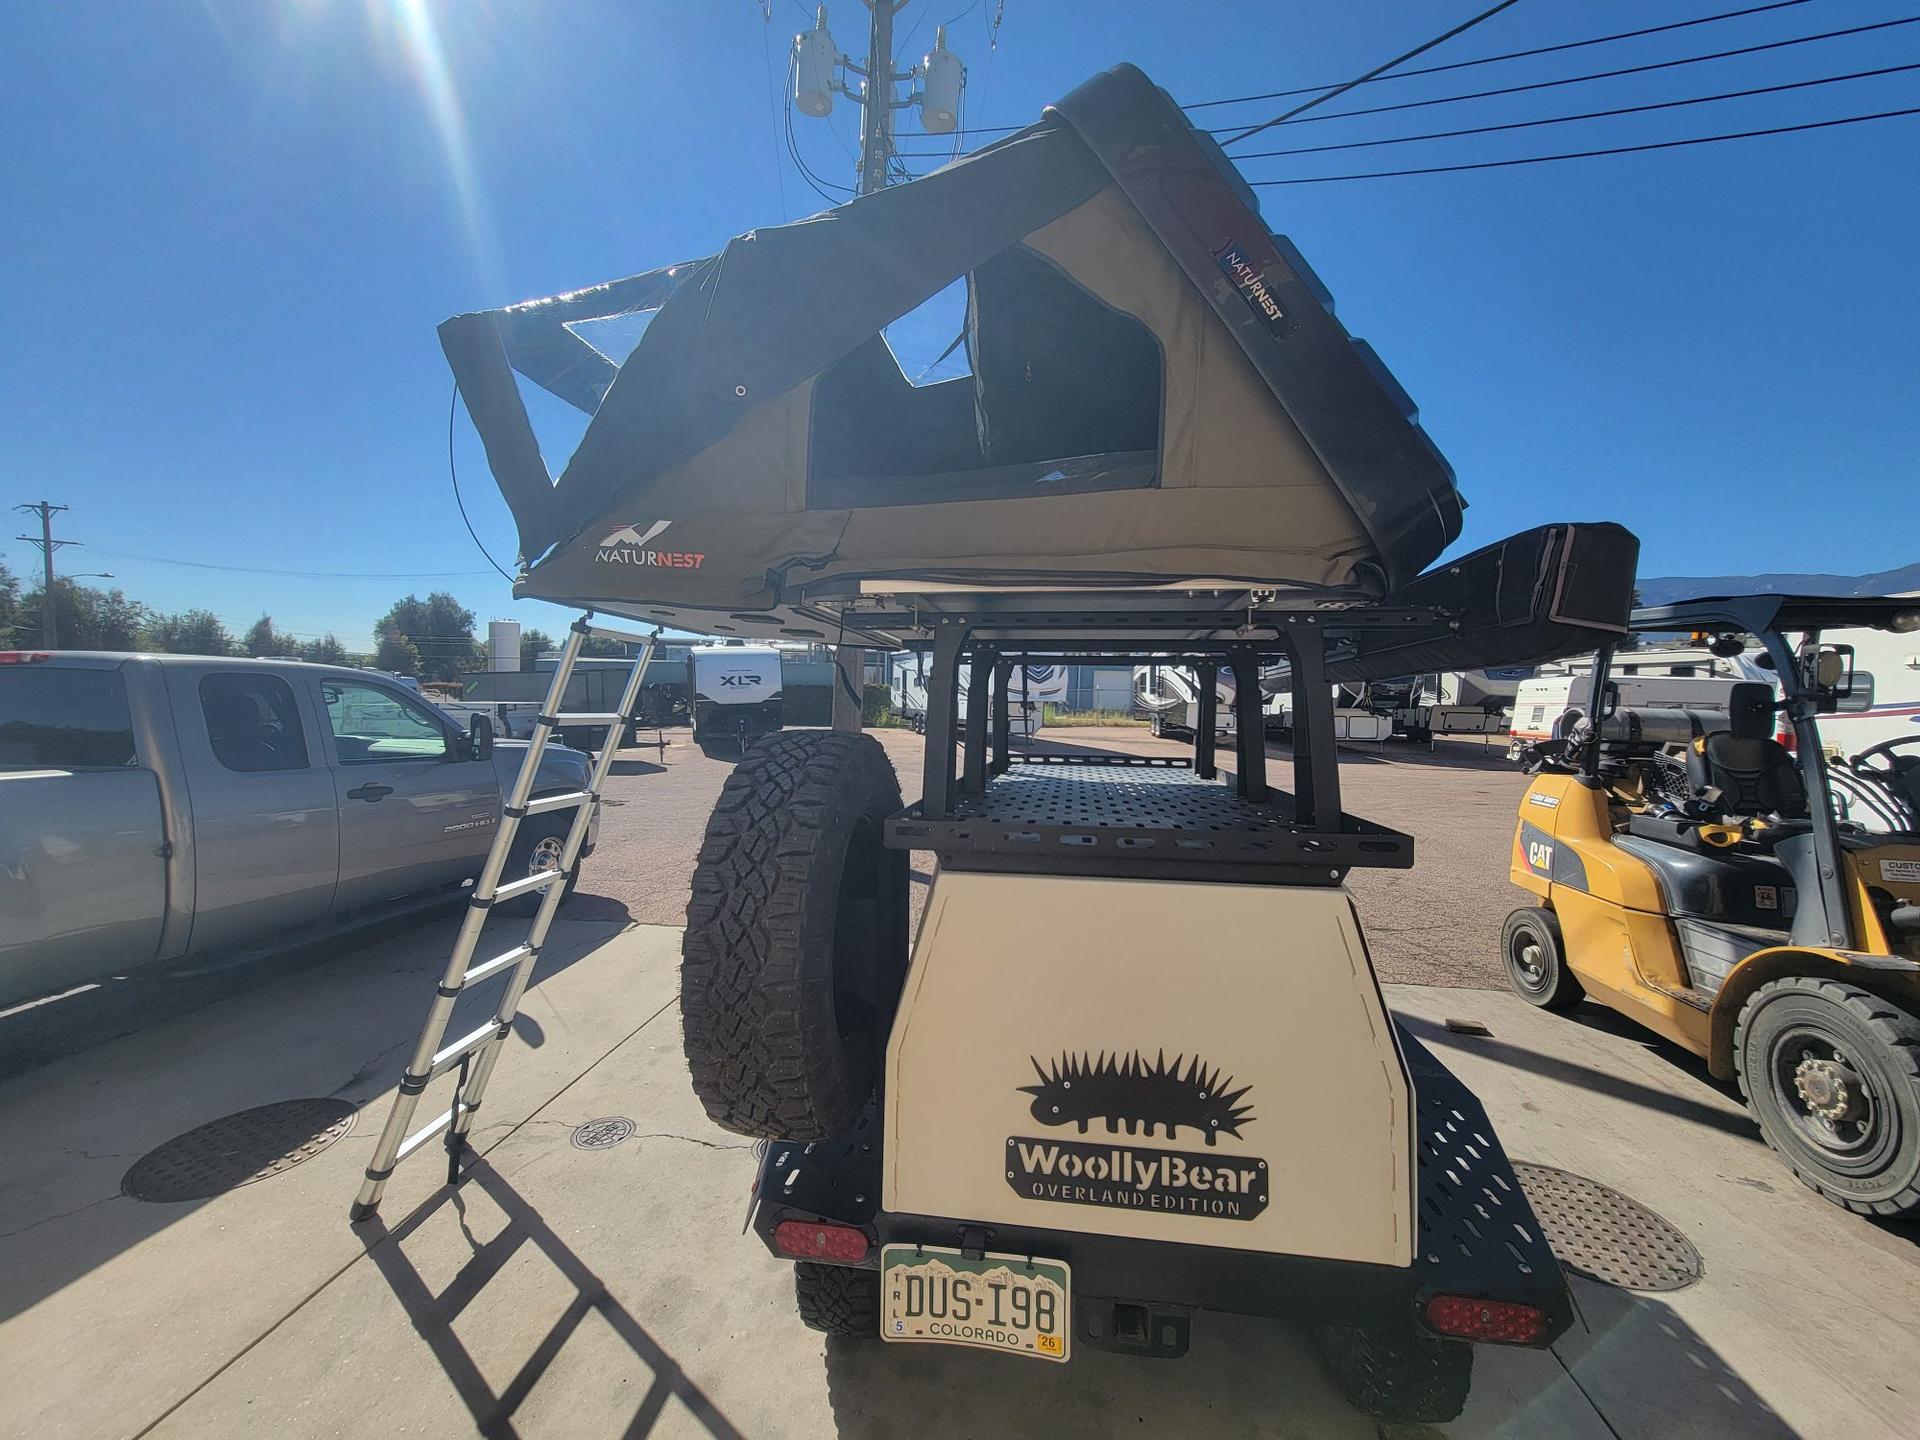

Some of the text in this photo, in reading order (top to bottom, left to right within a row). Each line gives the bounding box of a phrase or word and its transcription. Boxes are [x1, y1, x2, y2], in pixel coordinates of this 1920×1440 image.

[1226, 252, 1283, 320] NATURNEST
[595, 548, 705, 569] NATURNEST
[720, 675, 762, 686] XLR
[1529, 841, 1552, 870] CAT
[1018, 1143, 1257, 1194] WoollyBear
[1032, 1182, 1240, 1216] OVERLAND EDITION
[929, 1322, 1020, 1346] COLORADO
[1041, 1335, 1056, 1348] 26
